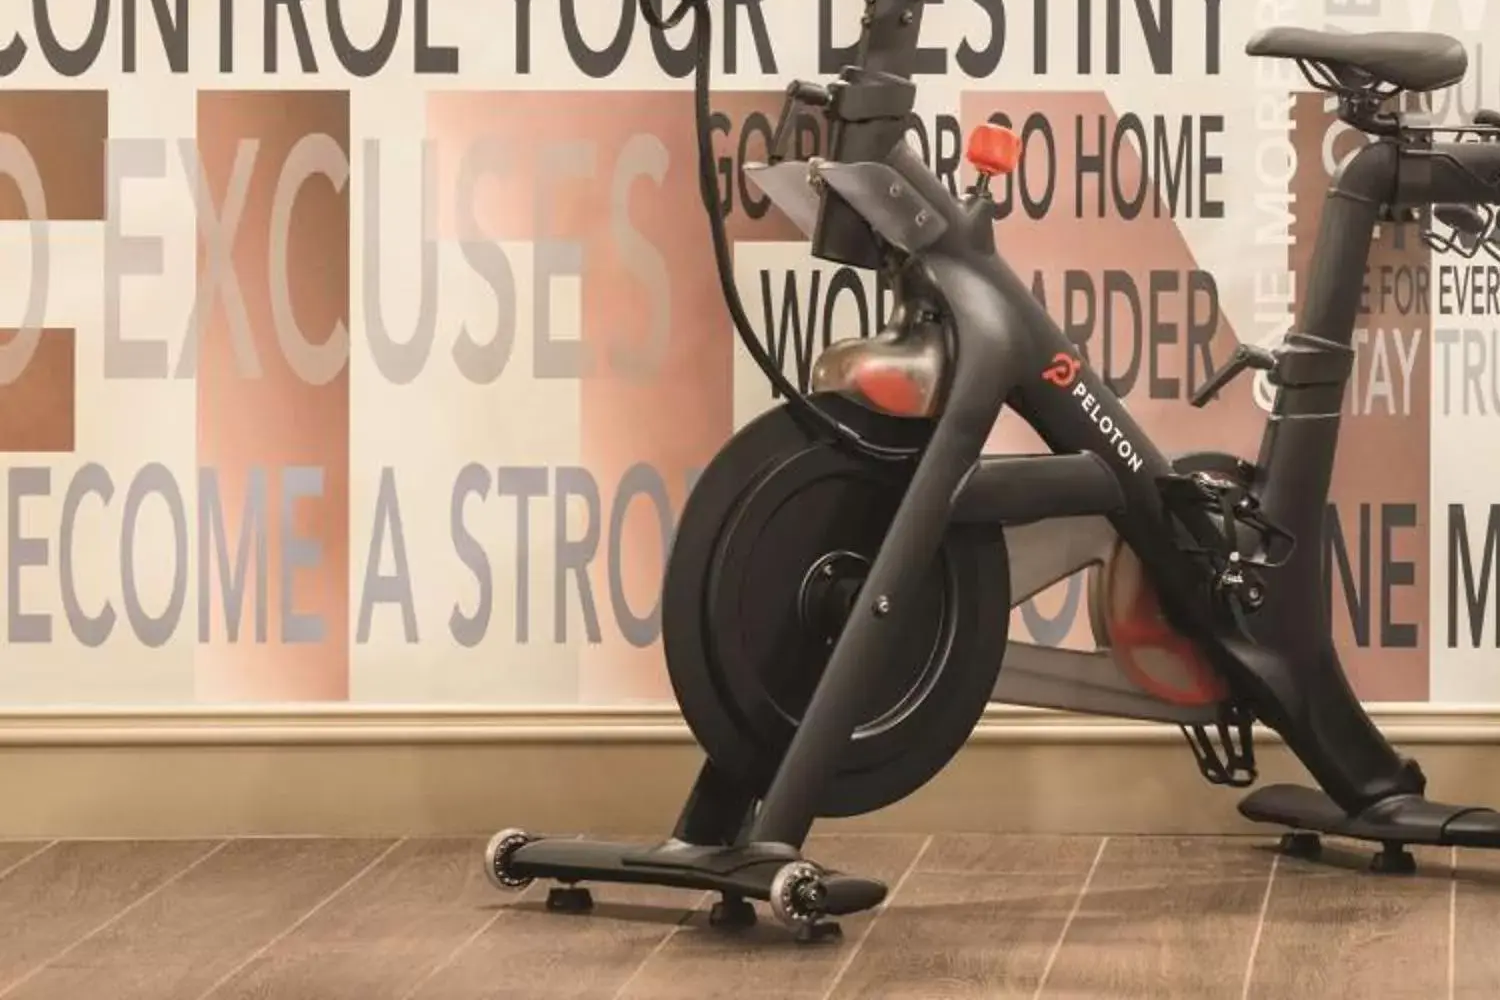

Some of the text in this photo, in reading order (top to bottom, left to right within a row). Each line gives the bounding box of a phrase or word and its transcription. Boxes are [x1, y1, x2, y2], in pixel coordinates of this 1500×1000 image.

[1075, 112, 1224, 220] HOME
[102, 132, 673, 386] EXCUSES
[1381, 265, 1431, 315] FOR
[1072, 381, 1143, 472] PELOTON
[1351, 328, 1422, 417] TAY
[6, 461, 708, 648] ECOME A STRO
[1326, 502, 1419, 649] NE
